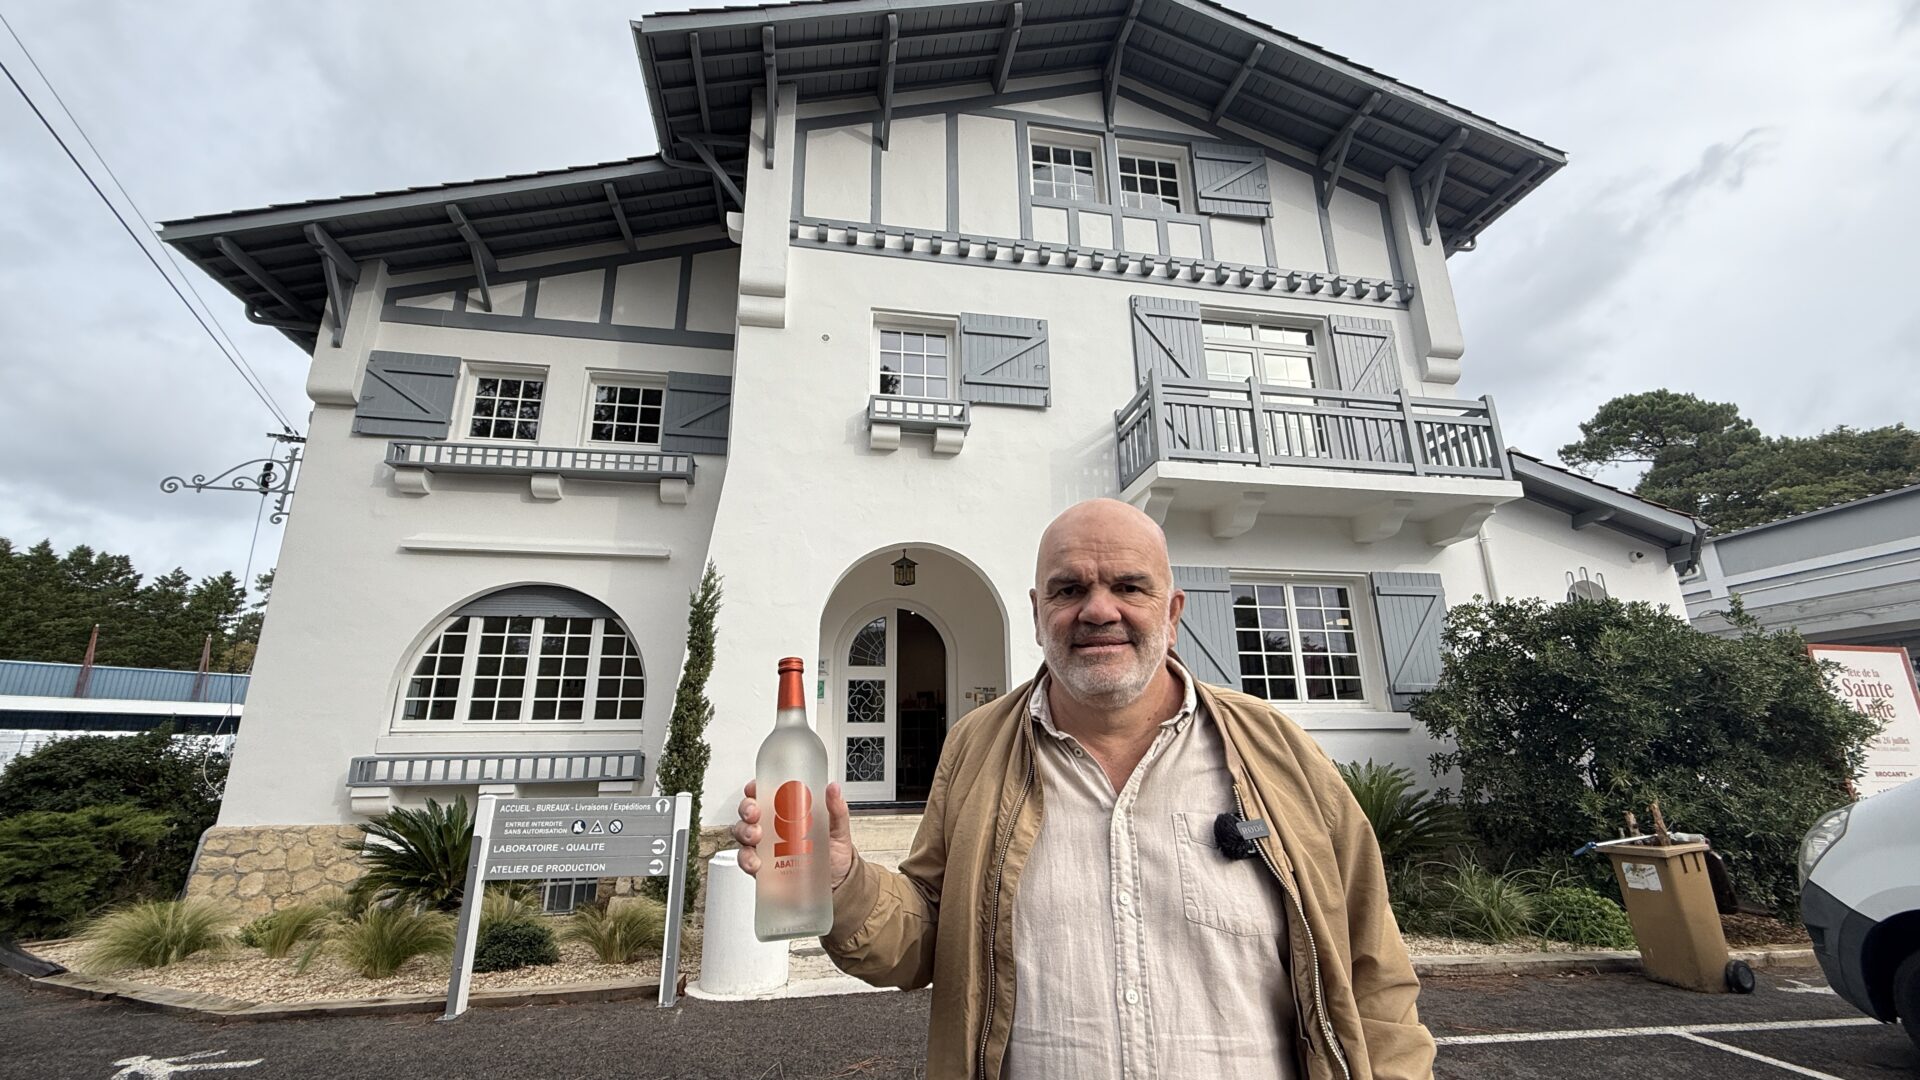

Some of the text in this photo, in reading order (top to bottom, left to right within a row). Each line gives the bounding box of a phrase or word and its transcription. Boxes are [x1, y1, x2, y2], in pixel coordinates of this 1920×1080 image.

[1862, 668, 1872, 678] de
[1842, 678, 1895, 698] Sainte
[500, 804, 530, 812] ACCUEIL
[536, 804, 570, 812] BUREAUX
[575, 804, 608, 812] Livraisons
[614, 803, 651, 812] Expéditions
[493, 844, 558, 853] LABORATOIRE
[566, 843, 605, 852] QUALITE
[490, 864, 606, 874] ATELIER DE PRODUCTION
